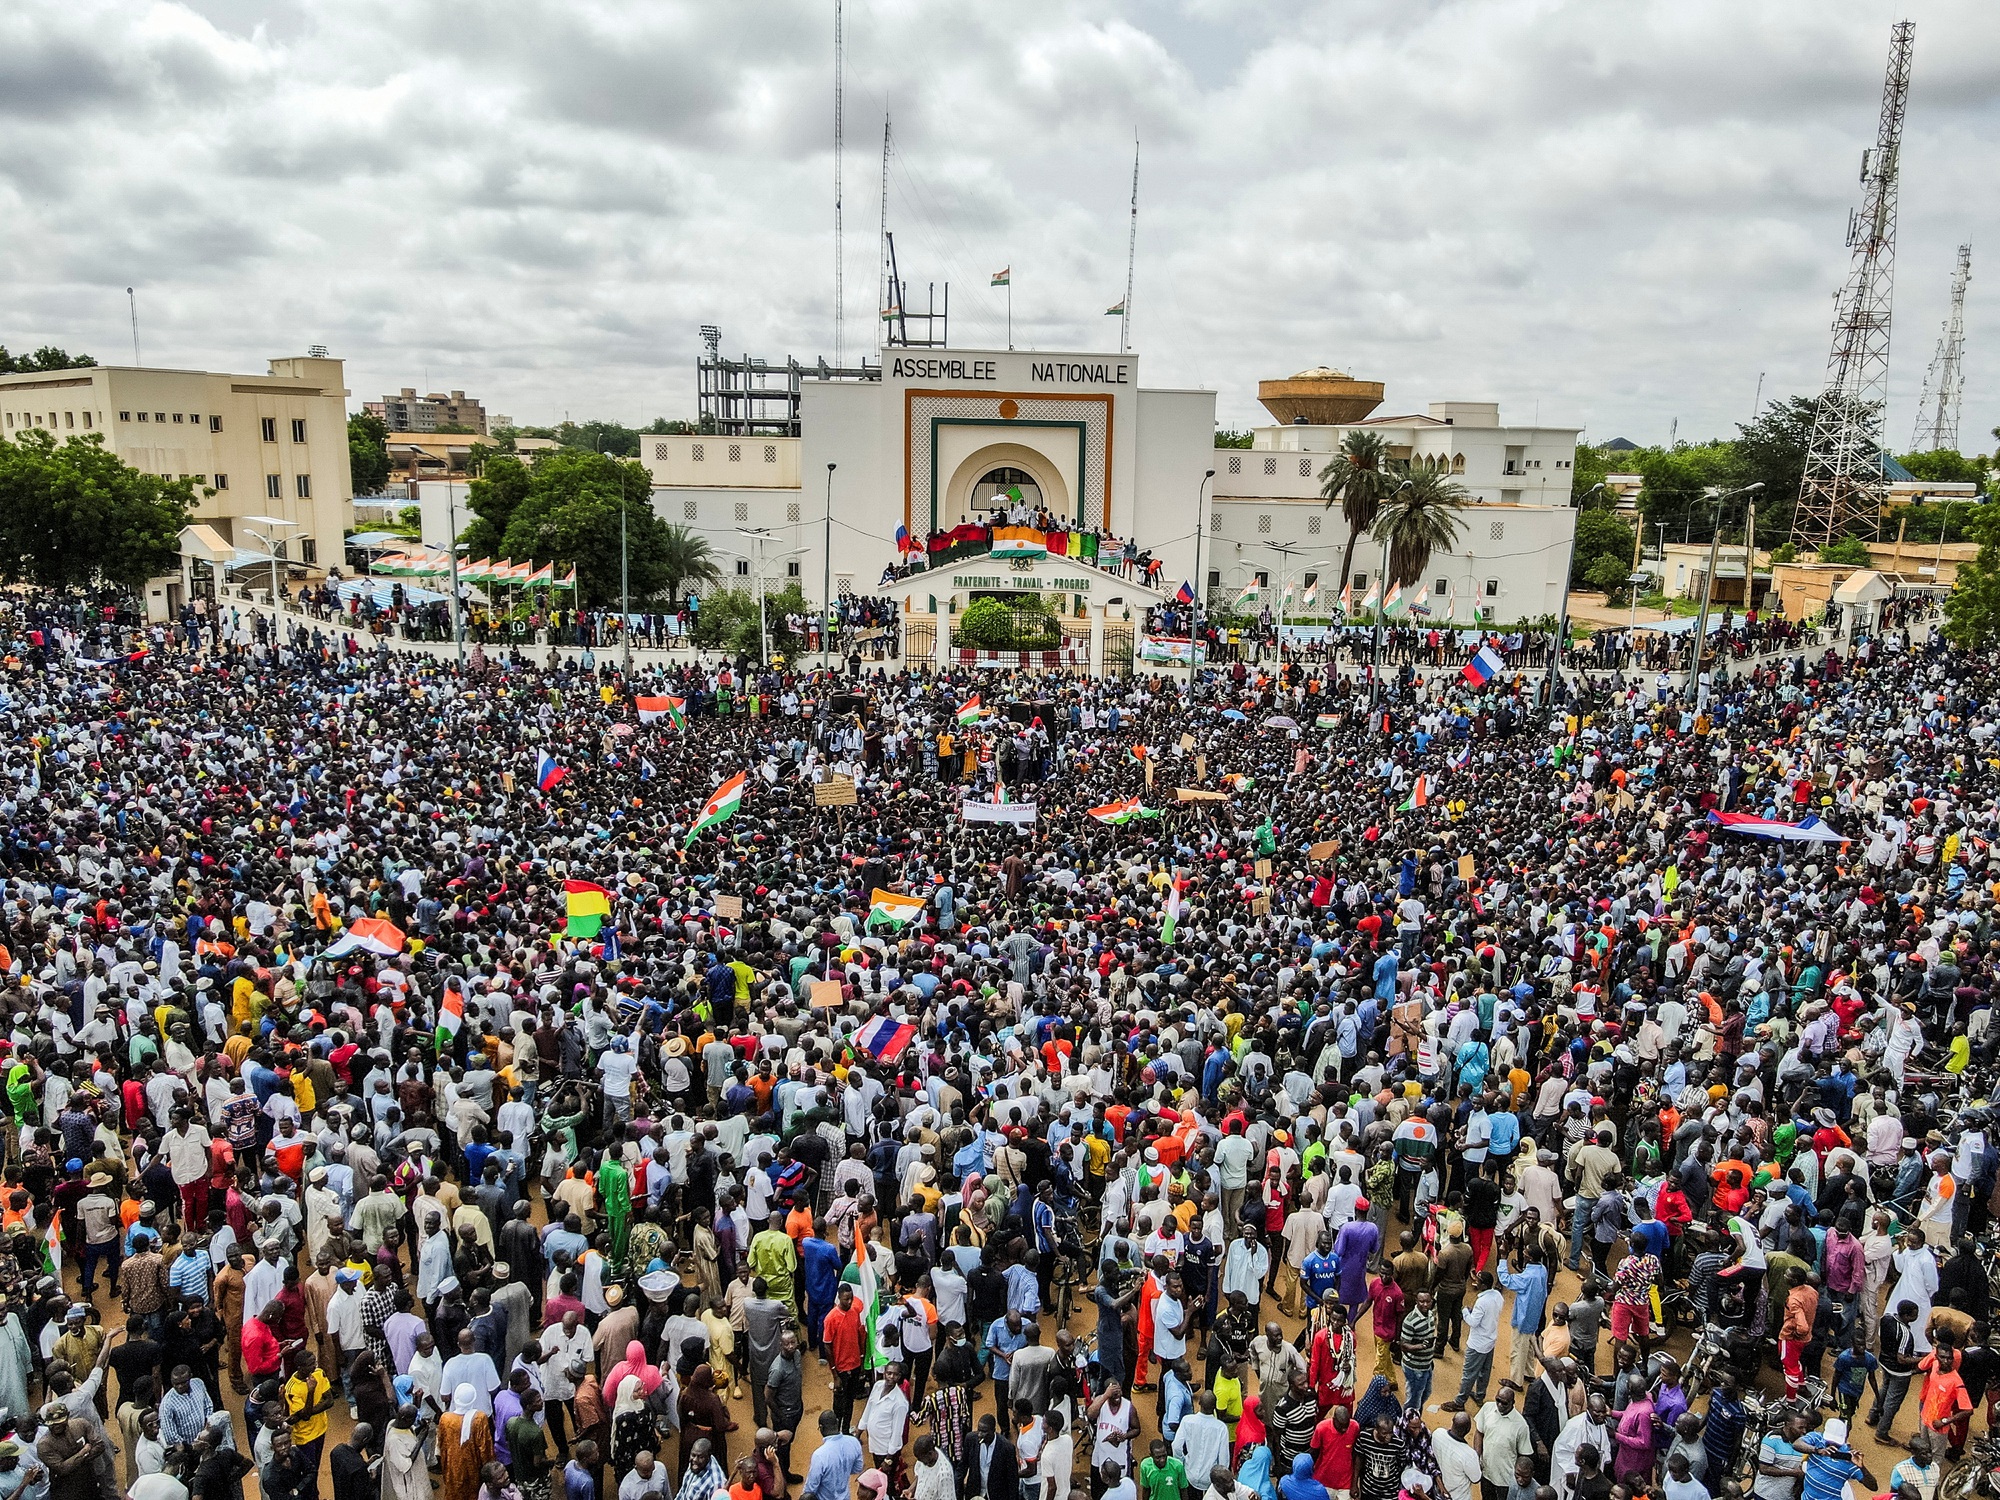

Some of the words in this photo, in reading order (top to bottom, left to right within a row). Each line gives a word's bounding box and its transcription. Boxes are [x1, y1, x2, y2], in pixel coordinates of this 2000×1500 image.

[892, 357, 997, 380] ASSEMBLEE
[1031, 362, 1128, 384] NATIONALE
[953, 575, 1001, 588] FRATERNITE
[1012, 576, 1044, 589] TRAVAIL
[1053, 577, 1090, 590] PROGRES
[1098, 1421, 1110, 1430] NEW
